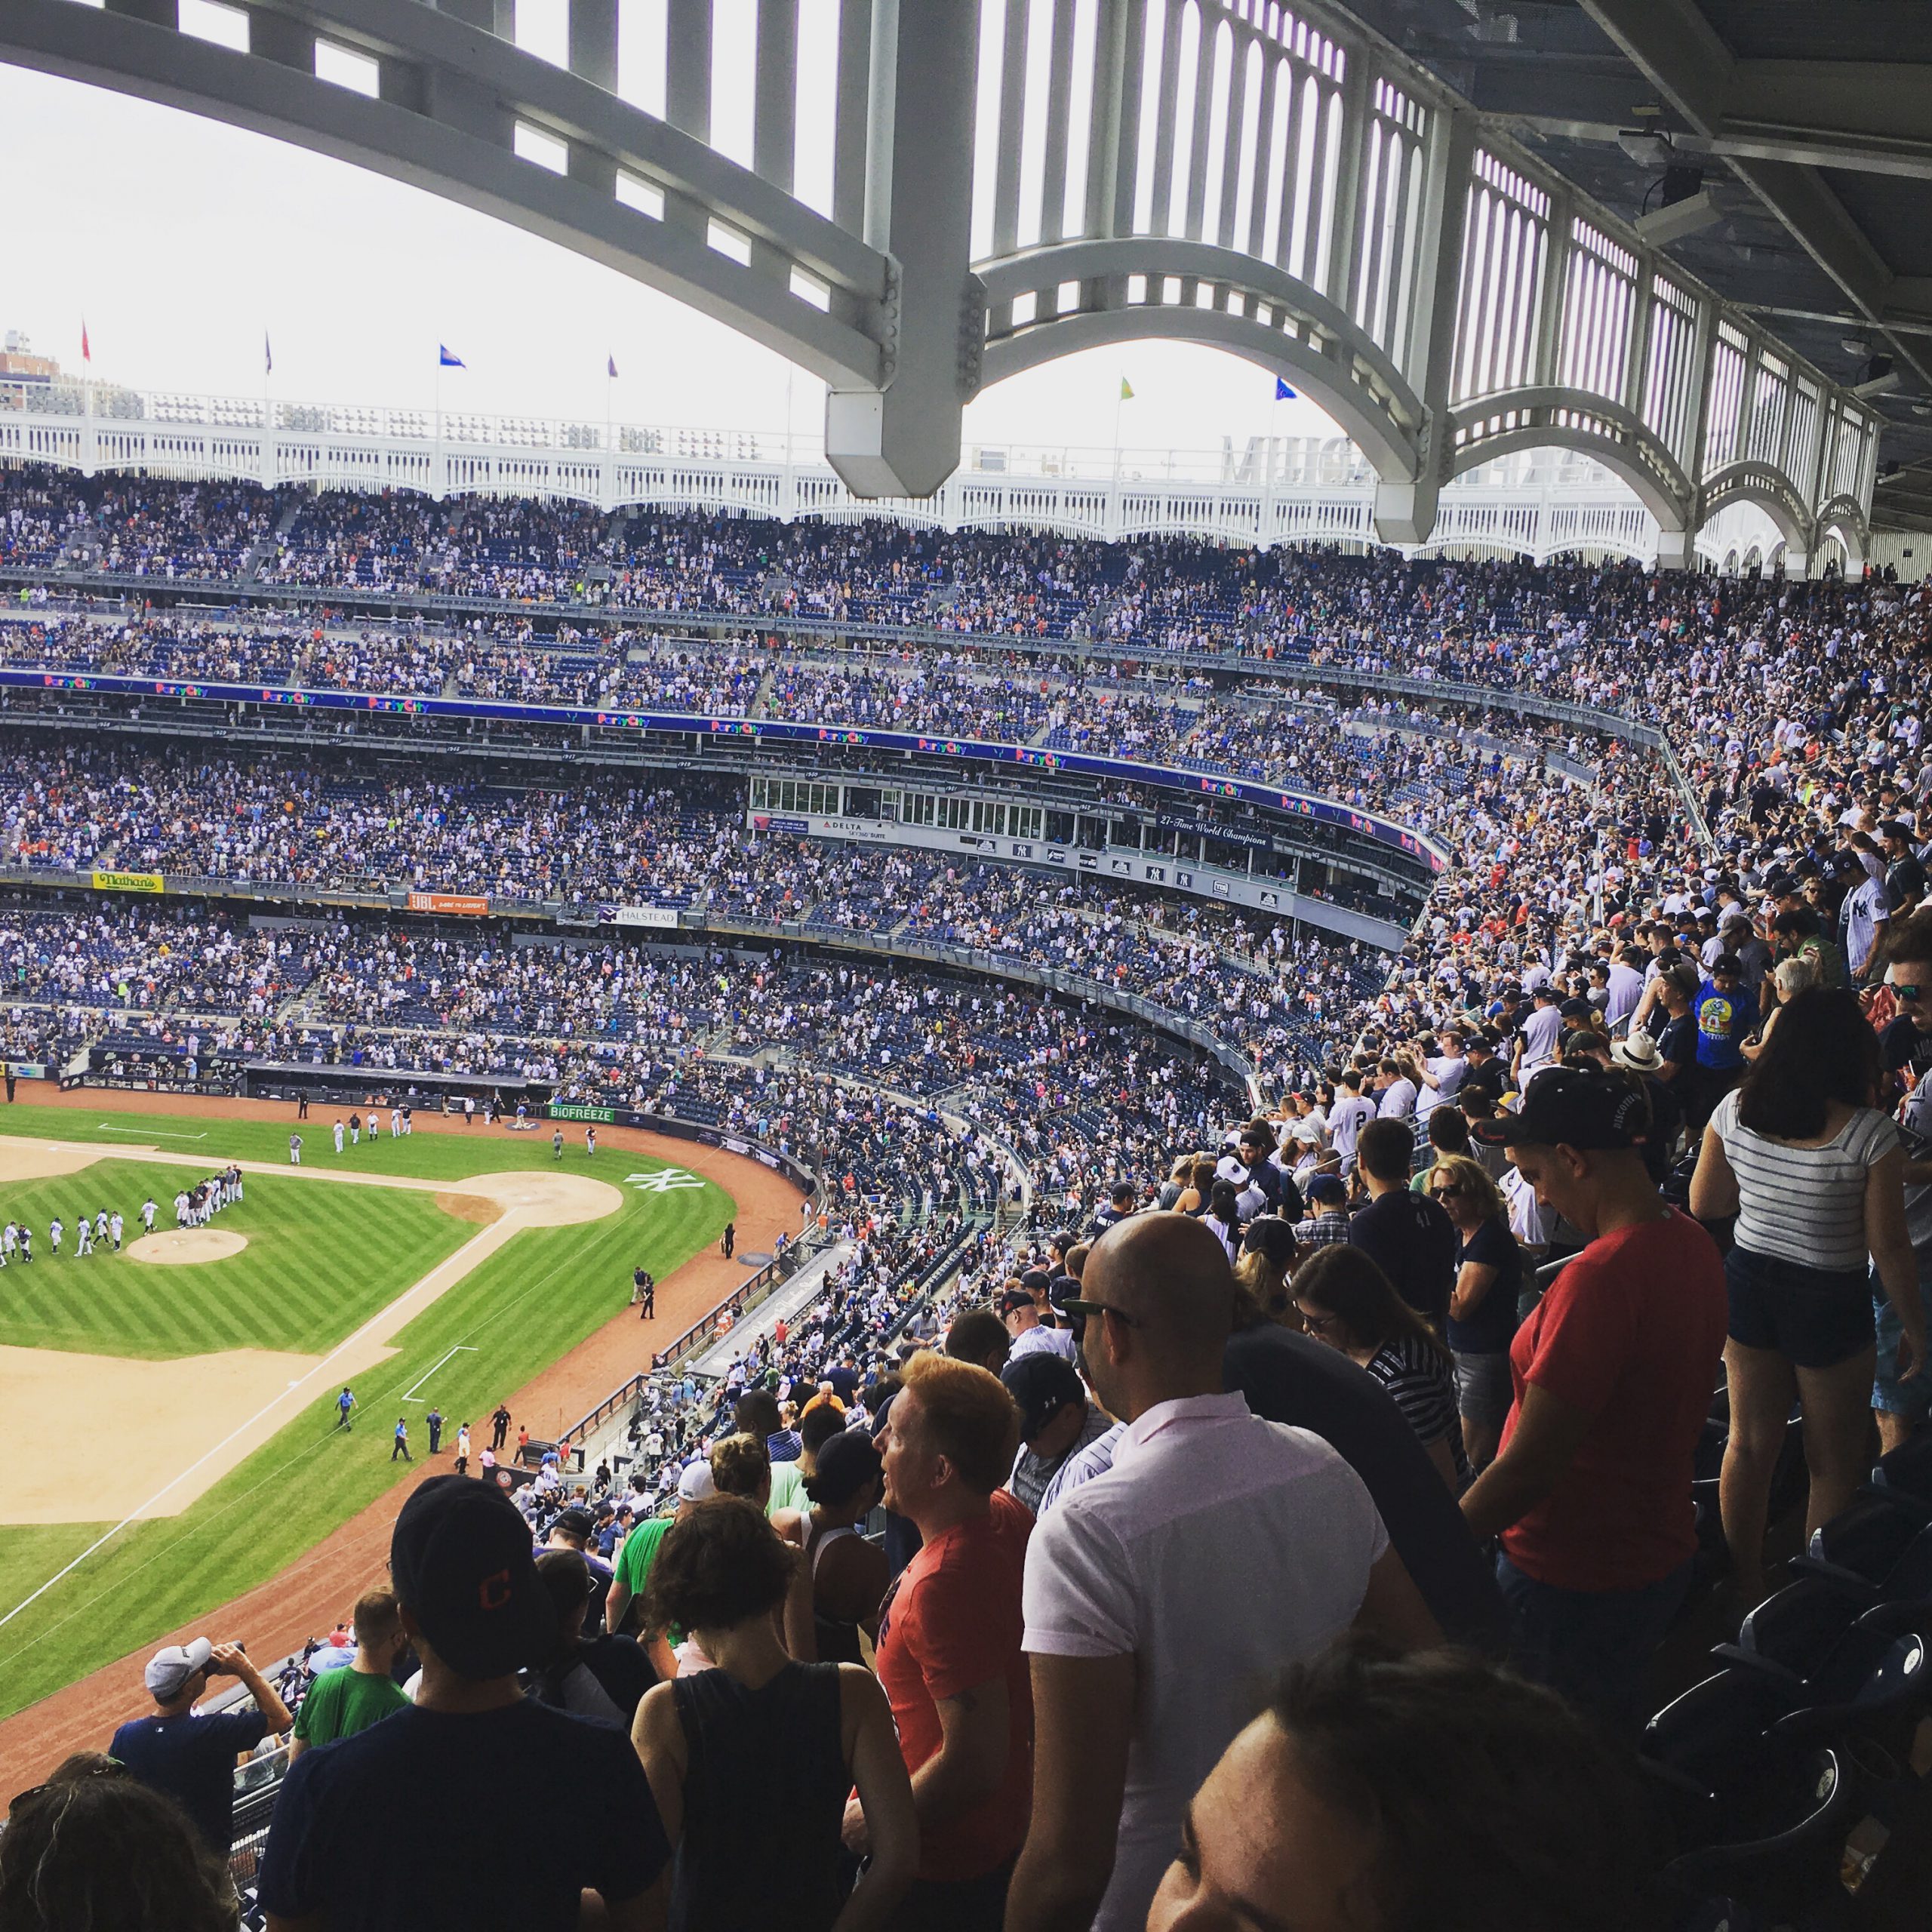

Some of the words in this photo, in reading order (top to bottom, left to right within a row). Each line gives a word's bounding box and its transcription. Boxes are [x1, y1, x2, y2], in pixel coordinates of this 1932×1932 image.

[832, 822, 861, 831] DELTA
[1161, 814, 1193, 830] 27-Time
[1195, 822, 1220, 836] World
[1223, 828, 1266, 845] Champions
[99, 872, 155, 888] Nathan's
[622, 911, 674, 922] HALSTEAD
[1355, 1110, 1367, 1131] 2
[479, 1569, 512, 1611] C
